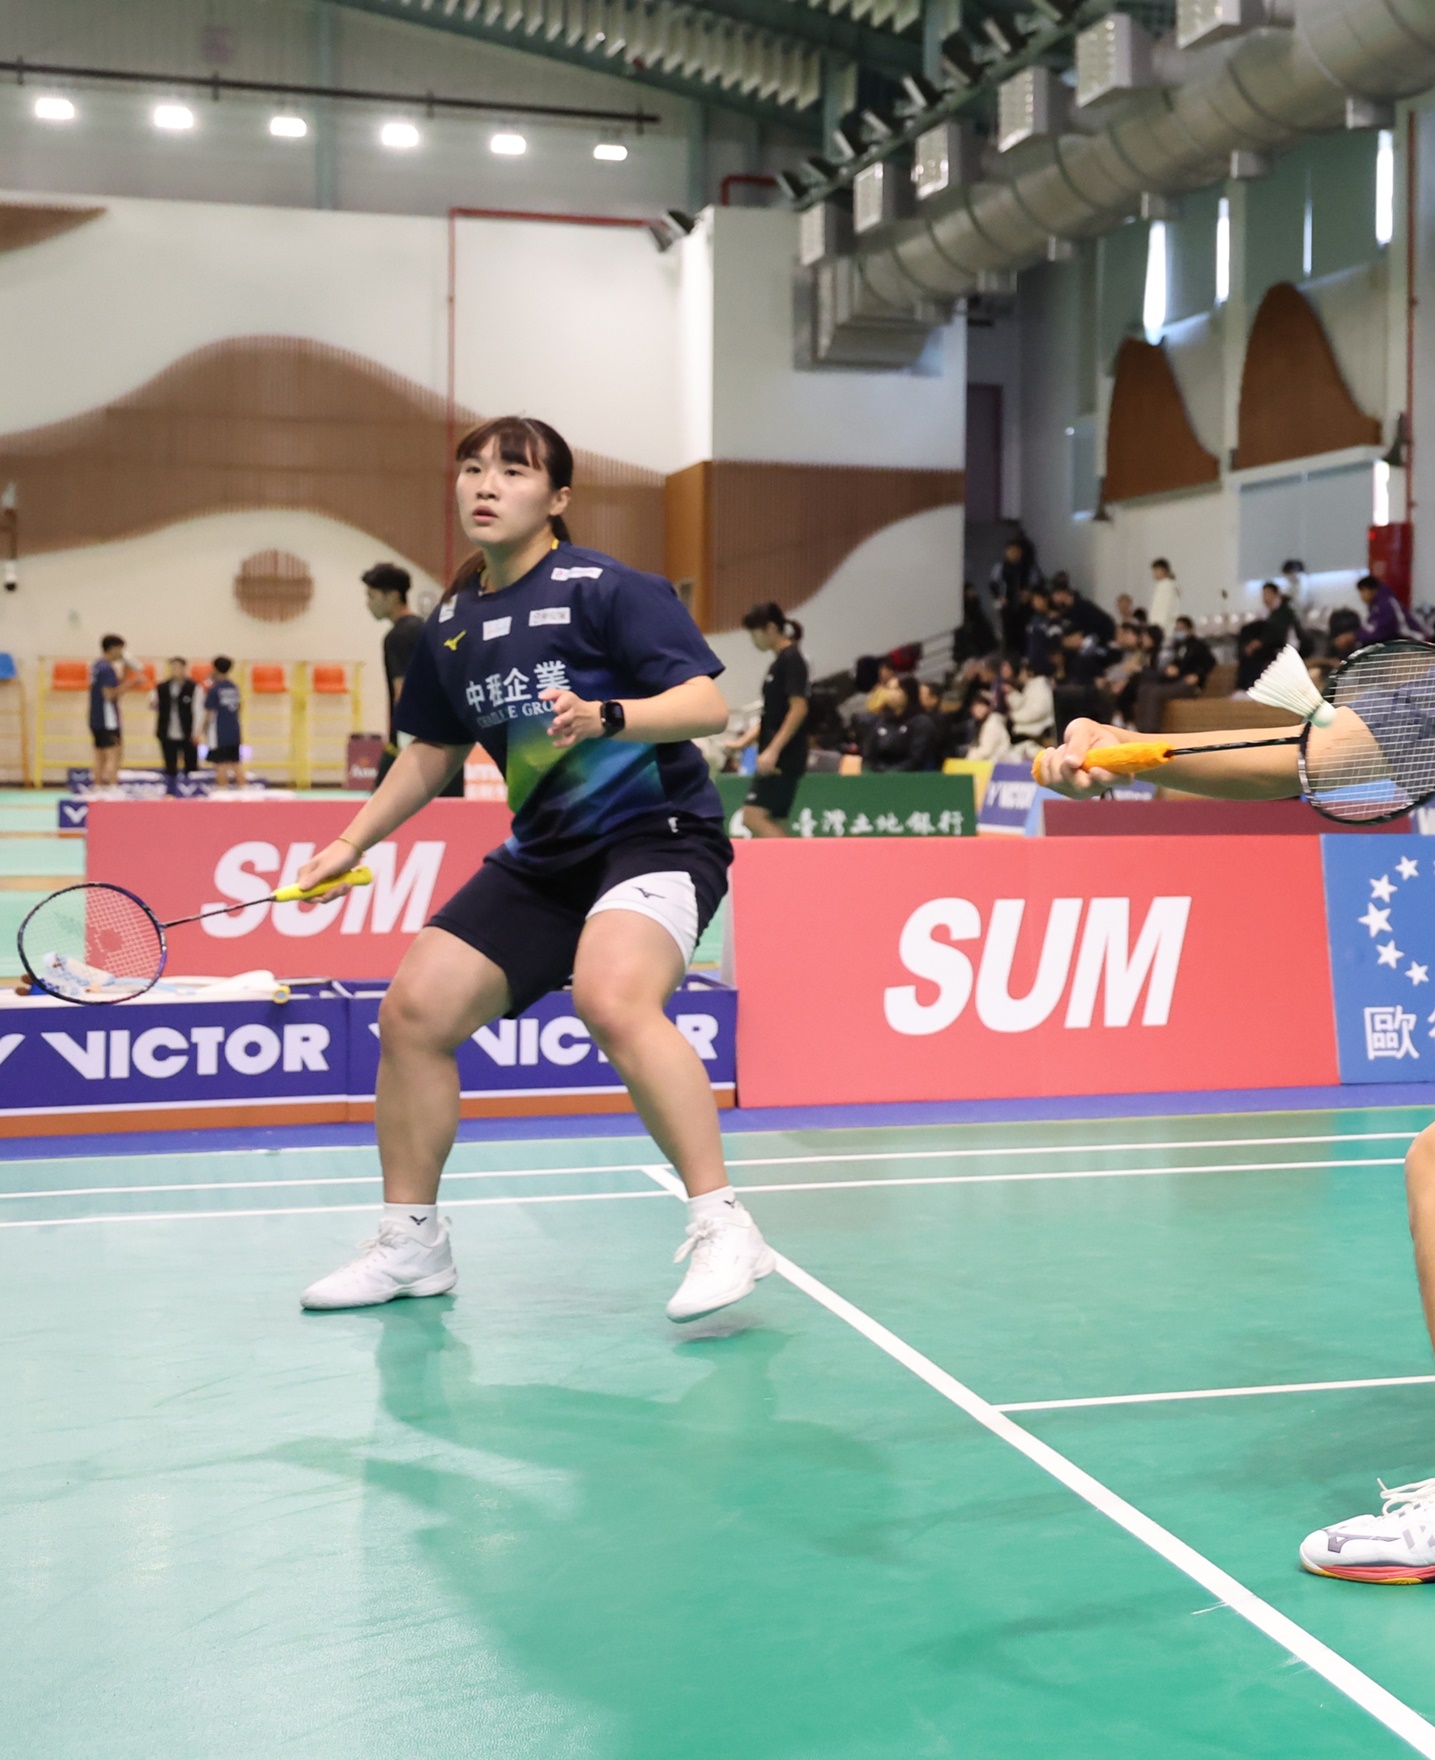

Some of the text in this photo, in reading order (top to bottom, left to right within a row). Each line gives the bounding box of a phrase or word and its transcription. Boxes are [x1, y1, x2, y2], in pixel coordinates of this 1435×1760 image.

[522, 700, 555, 717] GRO
[792, 807, 965, 837] 臺灣土地銀行
[200, 841, 447, 938] SUM
[883, 896, 1192, 1035] SUM
[41, 1023, 330, 1080] VICTOR
[471, 1014, 718, 1066] VICR
